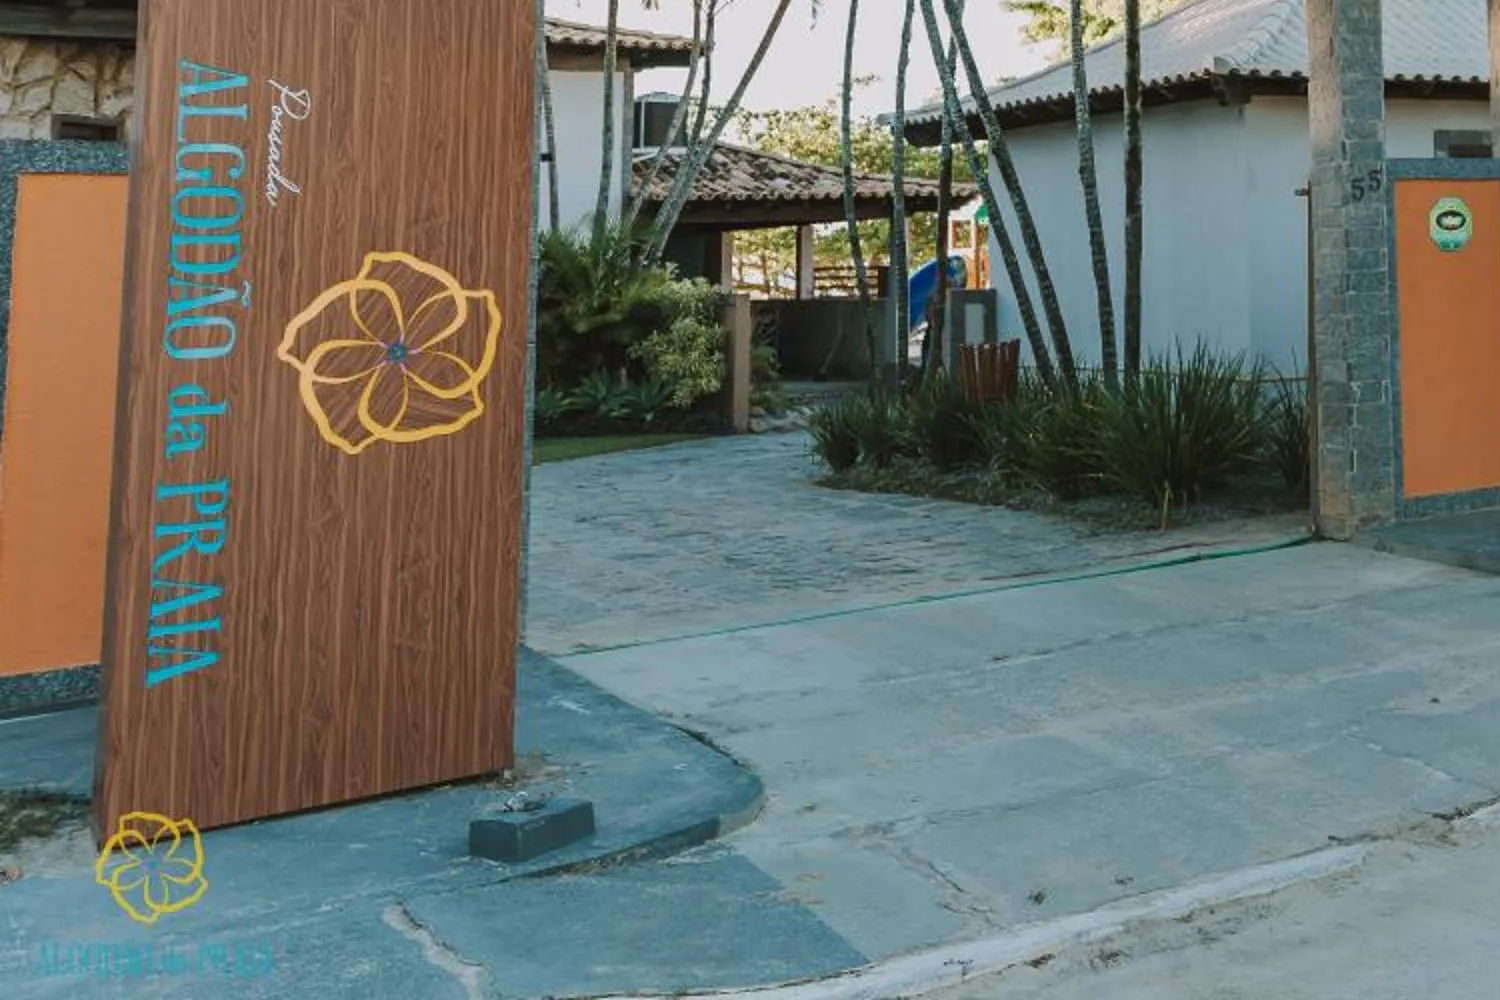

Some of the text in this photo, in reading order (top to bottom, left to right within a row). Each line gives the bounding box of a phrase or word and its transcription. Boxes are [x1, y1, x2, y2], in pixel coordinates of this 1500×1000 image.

[267, 78, 312, 208] Pousada
[1350, 166, 1383, 202] 55
[144, 57, 251, 689] ALGODÃO da PRAIA
